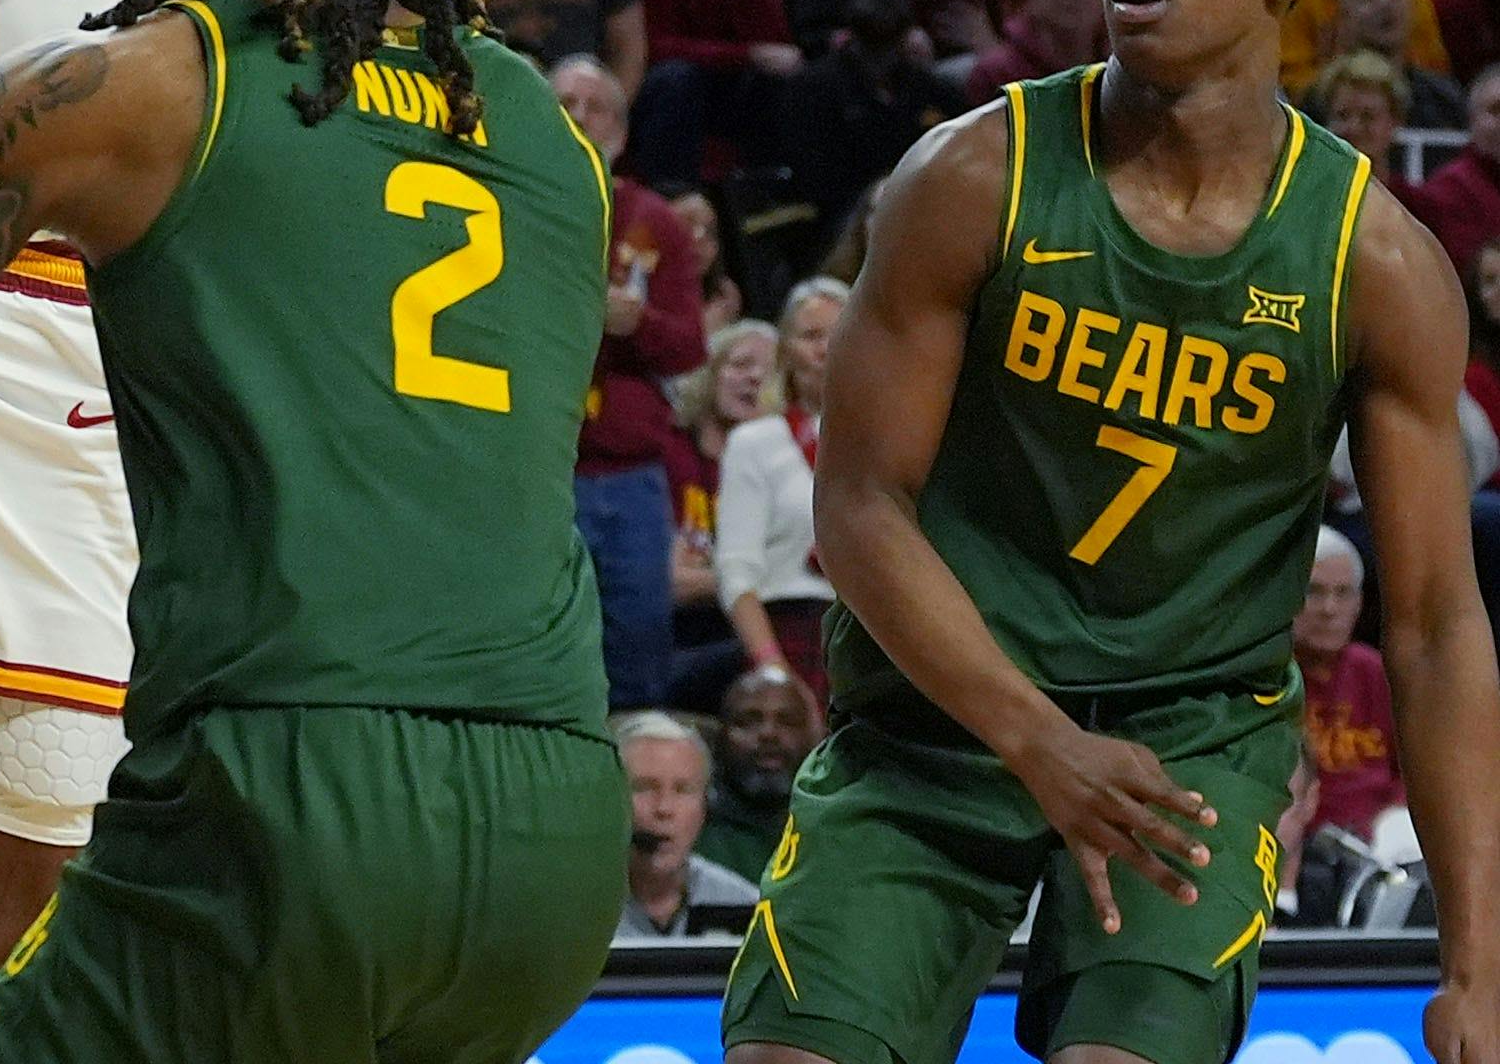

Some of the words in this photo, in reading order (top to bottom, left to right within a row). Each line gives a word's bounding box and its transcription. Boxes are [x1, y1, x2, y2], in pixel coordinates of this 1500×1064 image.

[351, 59, 489, 149] NUN
[384, 160, 512, 414] 2
[1003, 289, 1288, 435] BEARS
[1068, 423, 1178, 567] 7
